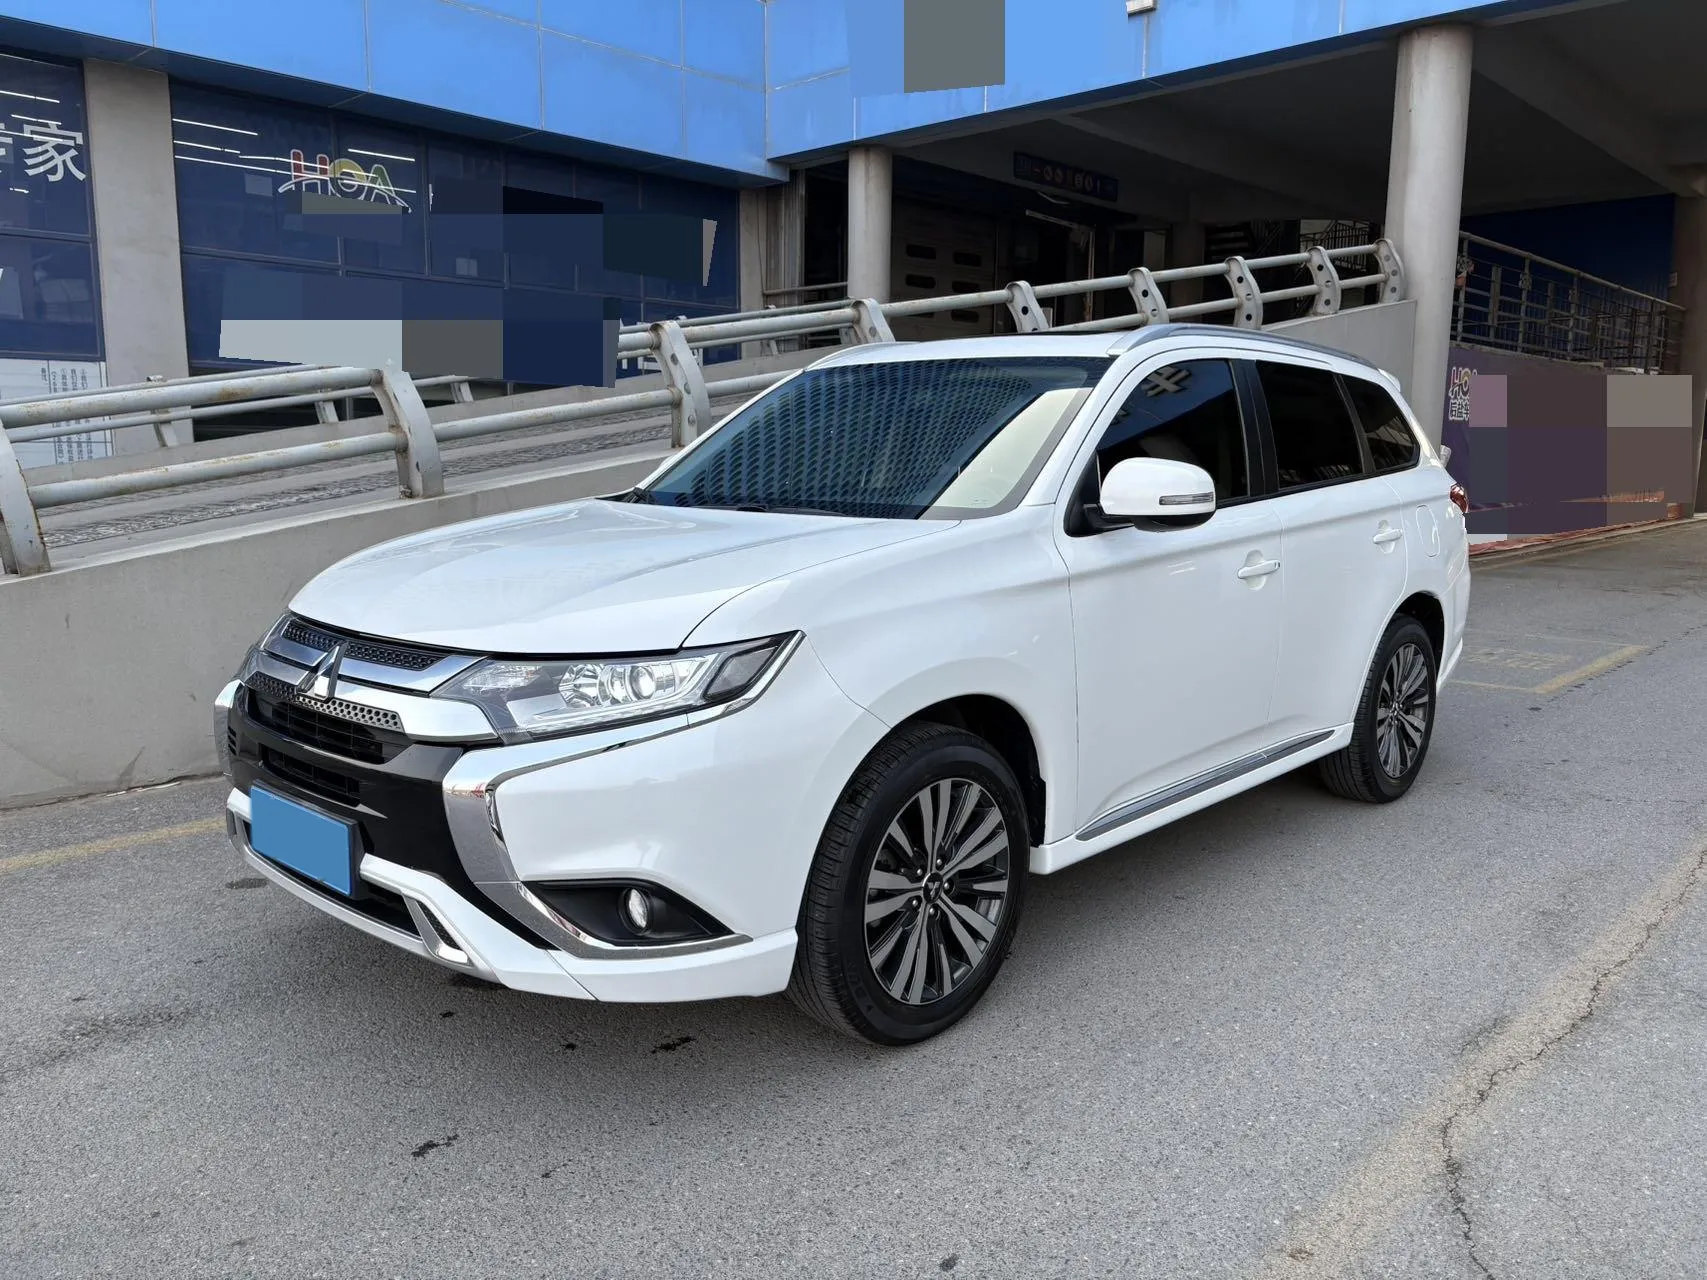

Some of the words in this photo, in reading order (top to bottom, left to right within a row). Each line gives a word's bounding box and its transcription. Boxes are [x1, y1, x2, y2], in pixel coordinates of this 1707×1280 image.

[0, 122, 86, 182] 家
[287, 149, 400, 206] HOA
[1449, 366, 1478, 399] HO
